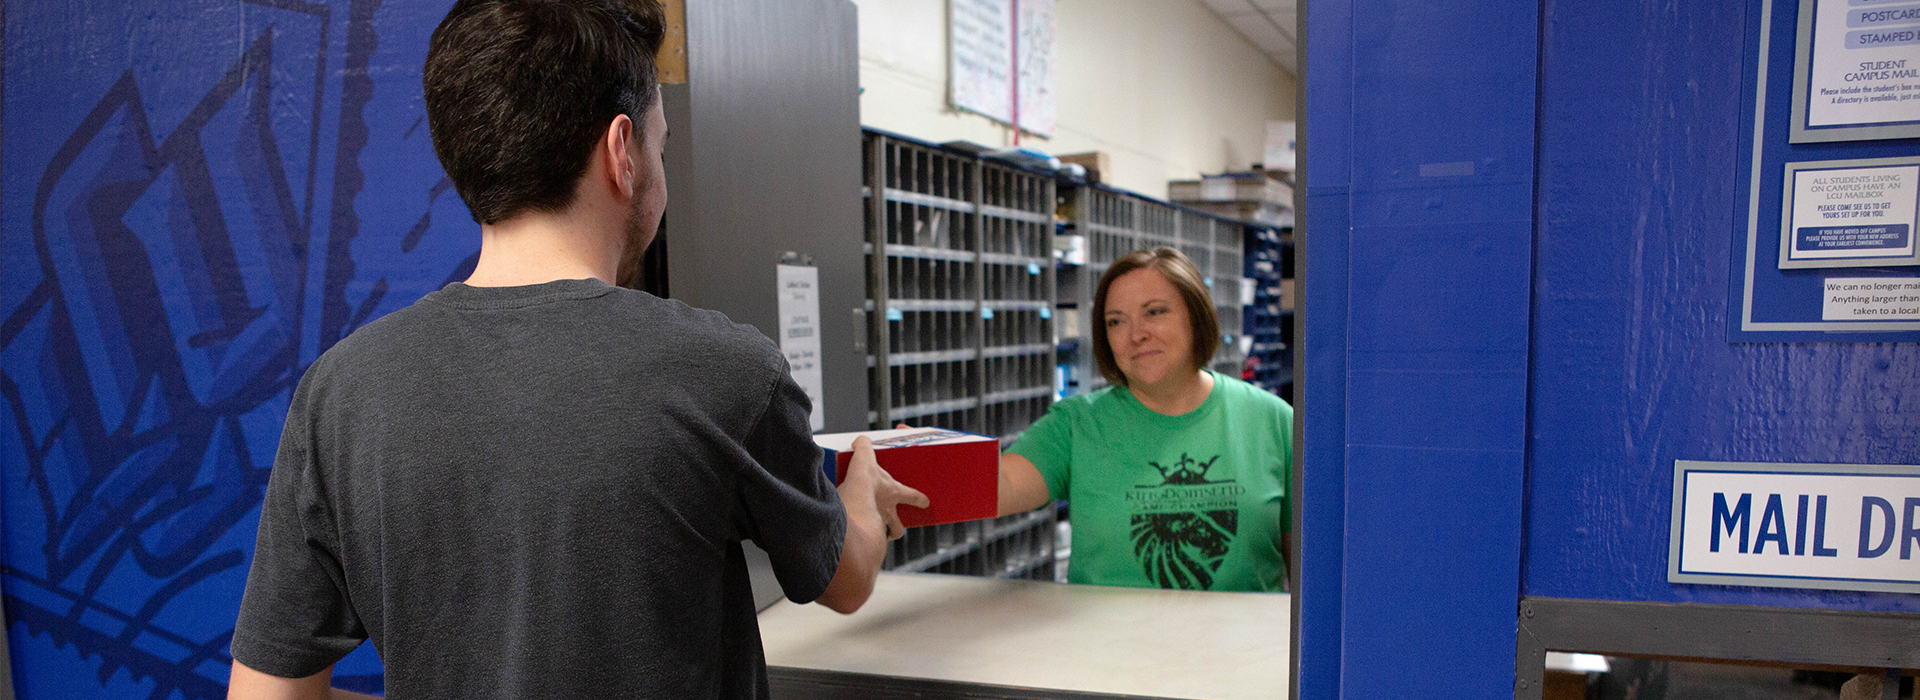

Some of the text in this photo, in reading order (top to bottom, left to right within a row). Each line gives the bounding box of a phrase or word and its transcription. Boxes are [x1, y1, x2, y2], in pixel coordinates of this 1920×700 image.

[1860, 31, 1914, 44] STAMPED
[1860, 60, 1906, 72] STUDENT
[1844, 69, 1920, 82] CAMPUS MAIL
[1820, 88, 1839, 96] Please
[1840, 86, 1860, 94] include
[1873, 84, 1900, 92] student's
[1901, 82, 1912, 90] box
[1837, 96, 1862, 104] directory
[1900, 93, 1911, 102] just
[1830, 176, 1870, 184] STUDENTS
[1826, 184, 1861, 192] CAMPUS
[1844, 190, 1884, 199] MAILBOX
[1874, 282, 1902, 292] longer
[1831, 294, 1920, 304] Anything larger than
[1854, 307, 1877, 315] taken
[1898, 306, 1919, 314] local
[1709, 492, 1920, 560] MAIL DR
